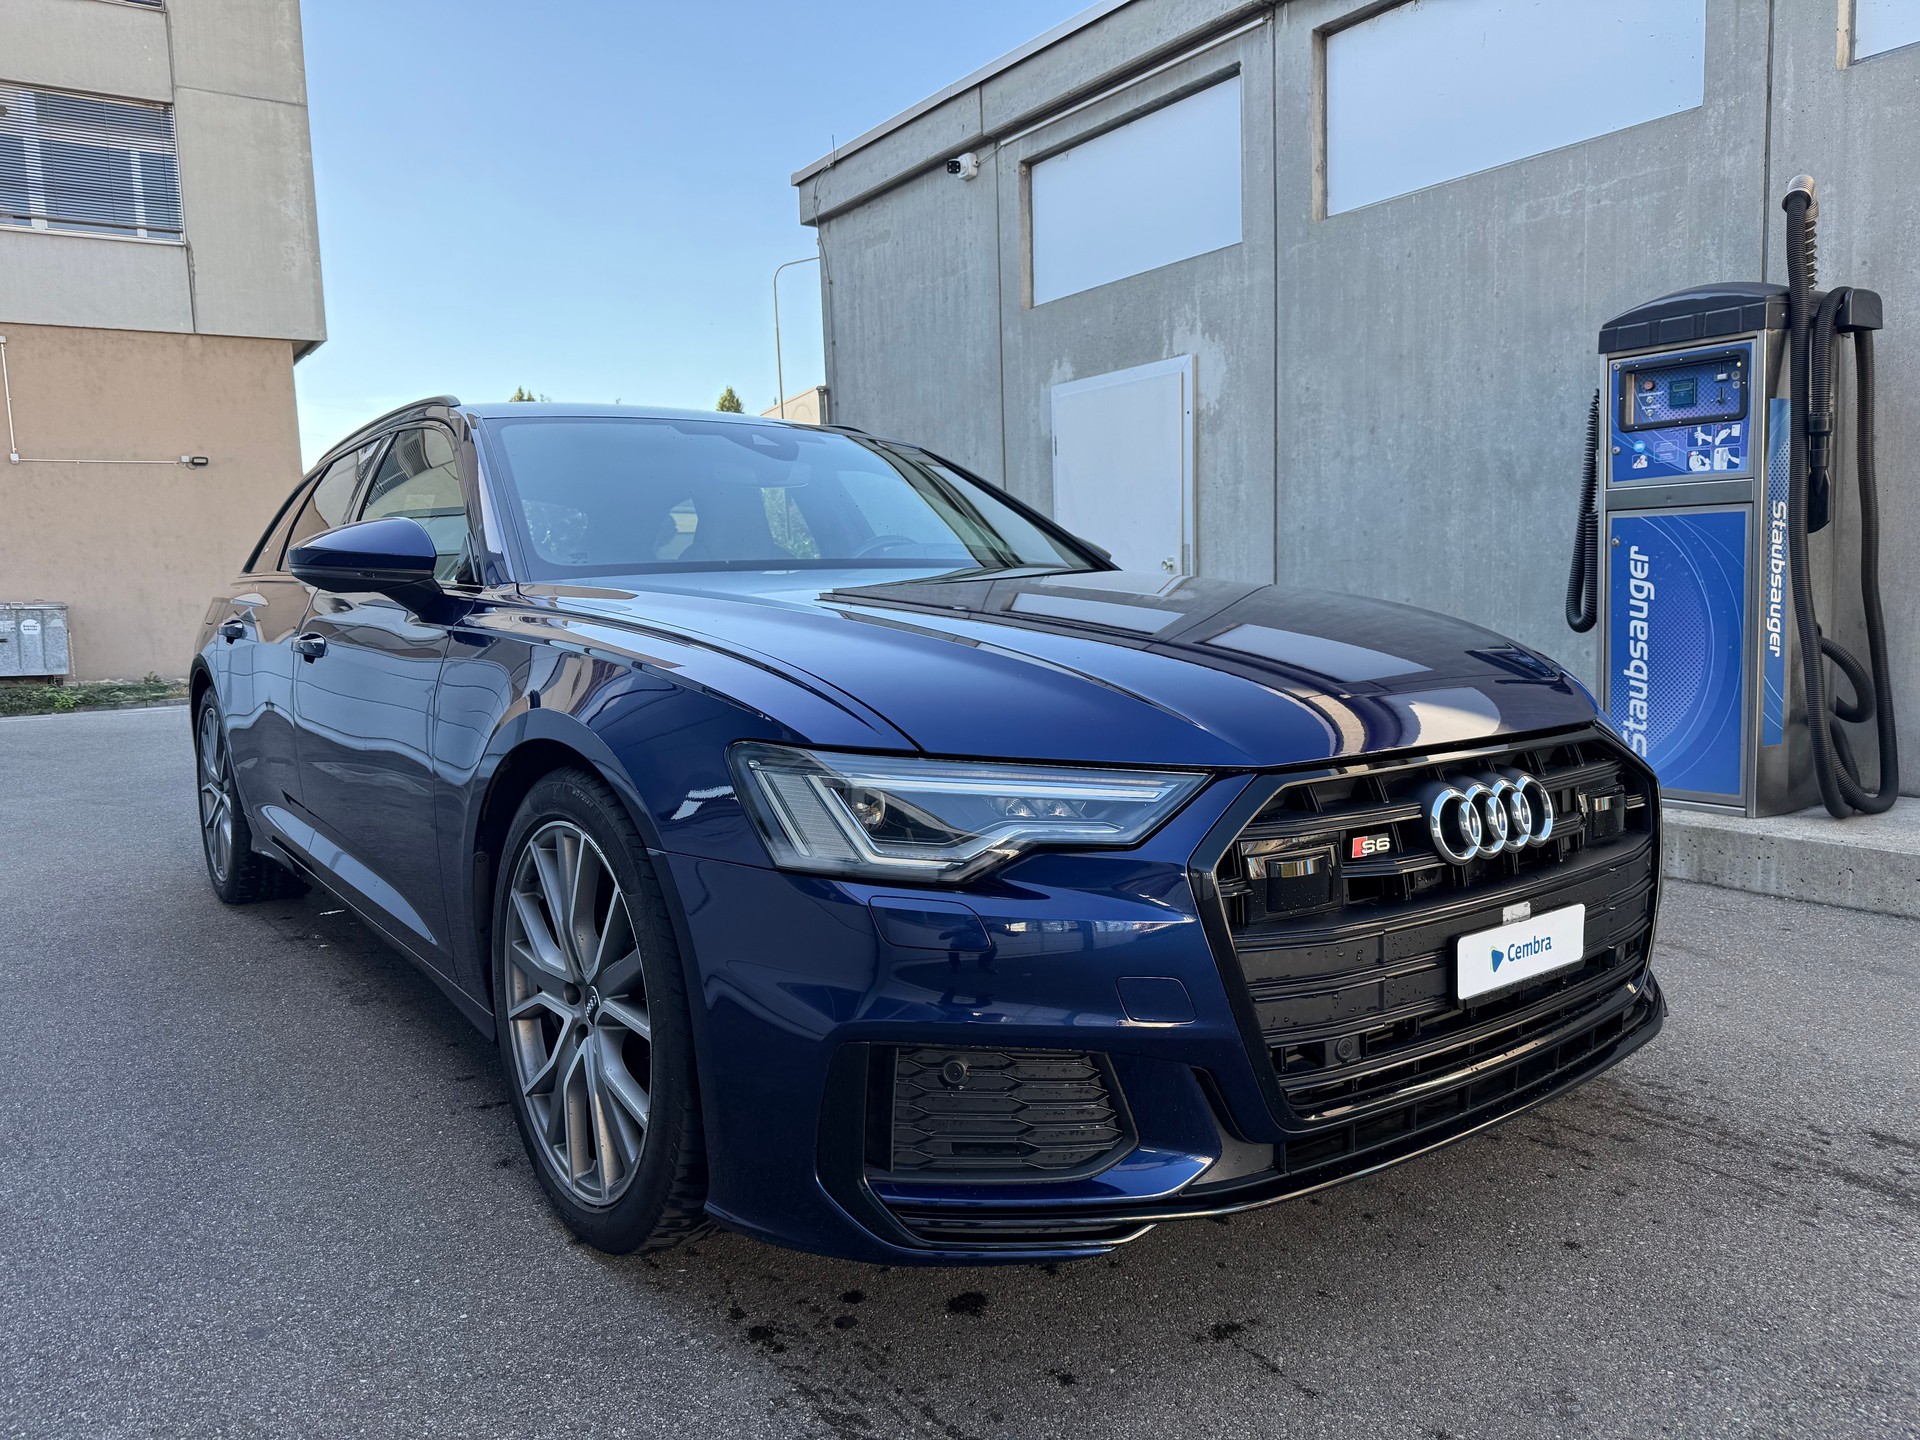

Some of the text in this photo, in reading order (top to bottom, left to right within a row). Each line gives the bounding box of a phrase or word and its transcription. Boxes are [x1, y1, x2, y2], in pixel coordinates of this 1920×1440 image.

[1766, 501, 1788, 658] Staubsauger
[1623, 545, 1655, 757] Staubsauger
[1361, 837, 1391, 854] S6
[1507, 935, 1552, 962] Cembra
